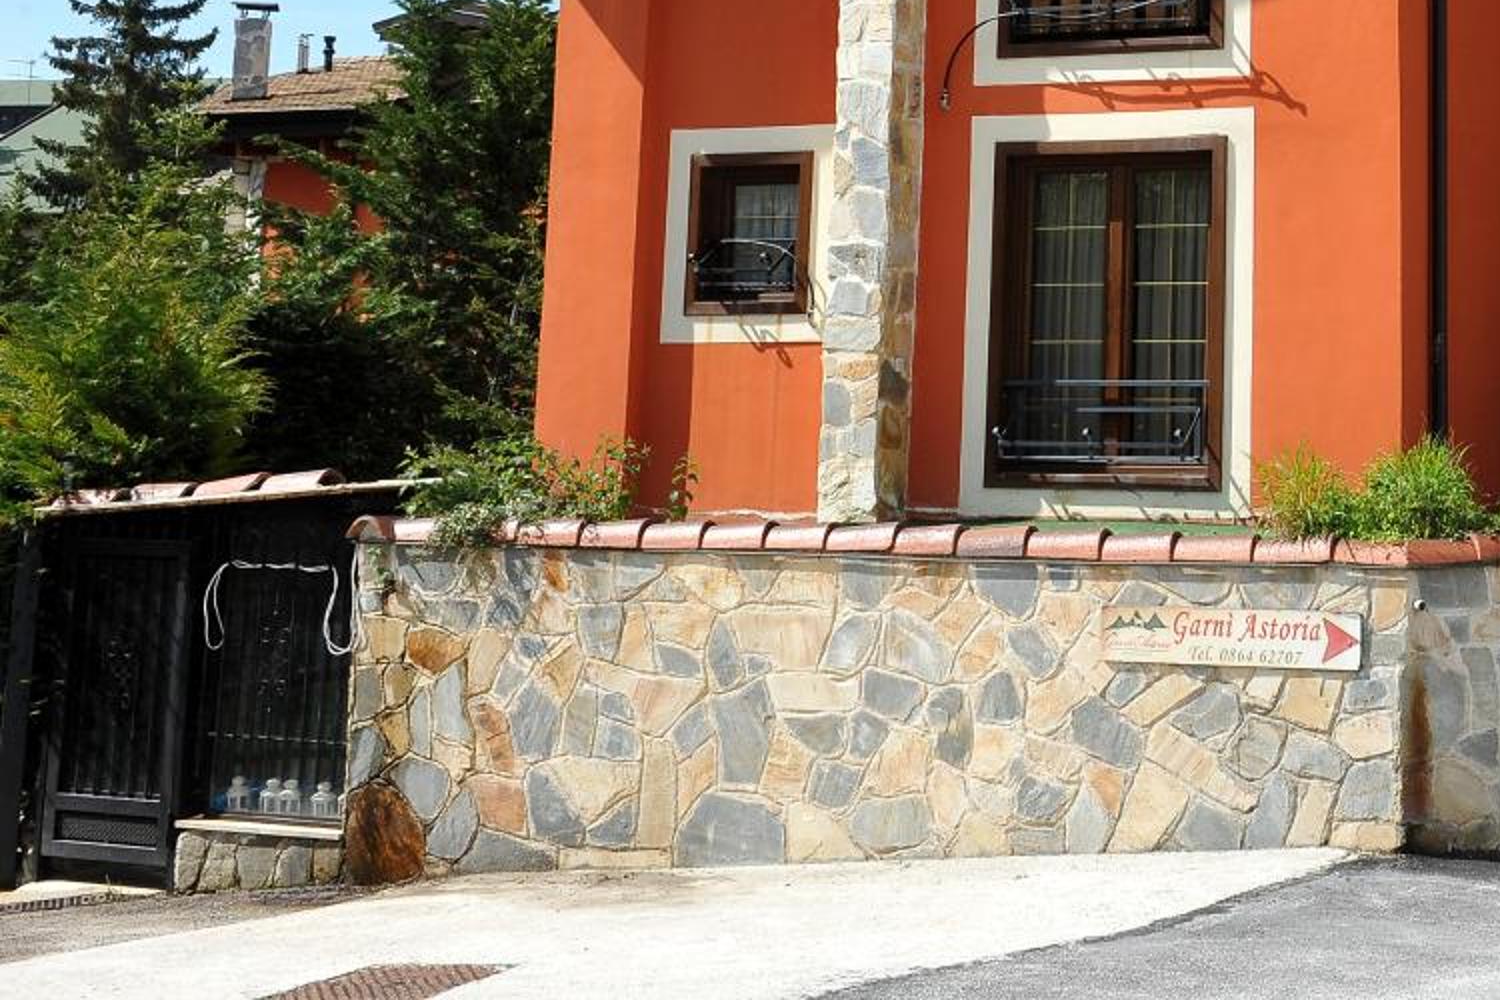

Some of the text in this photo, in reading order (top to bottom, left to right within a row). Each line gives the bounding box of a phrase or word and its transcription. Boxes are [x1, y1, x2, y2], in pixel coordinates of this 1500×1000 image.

[1239, 614, 1321, 641] Astoria
[1189, 646, 1213, 662] Tel.
[1219, 647, 1253, 662] 0864
